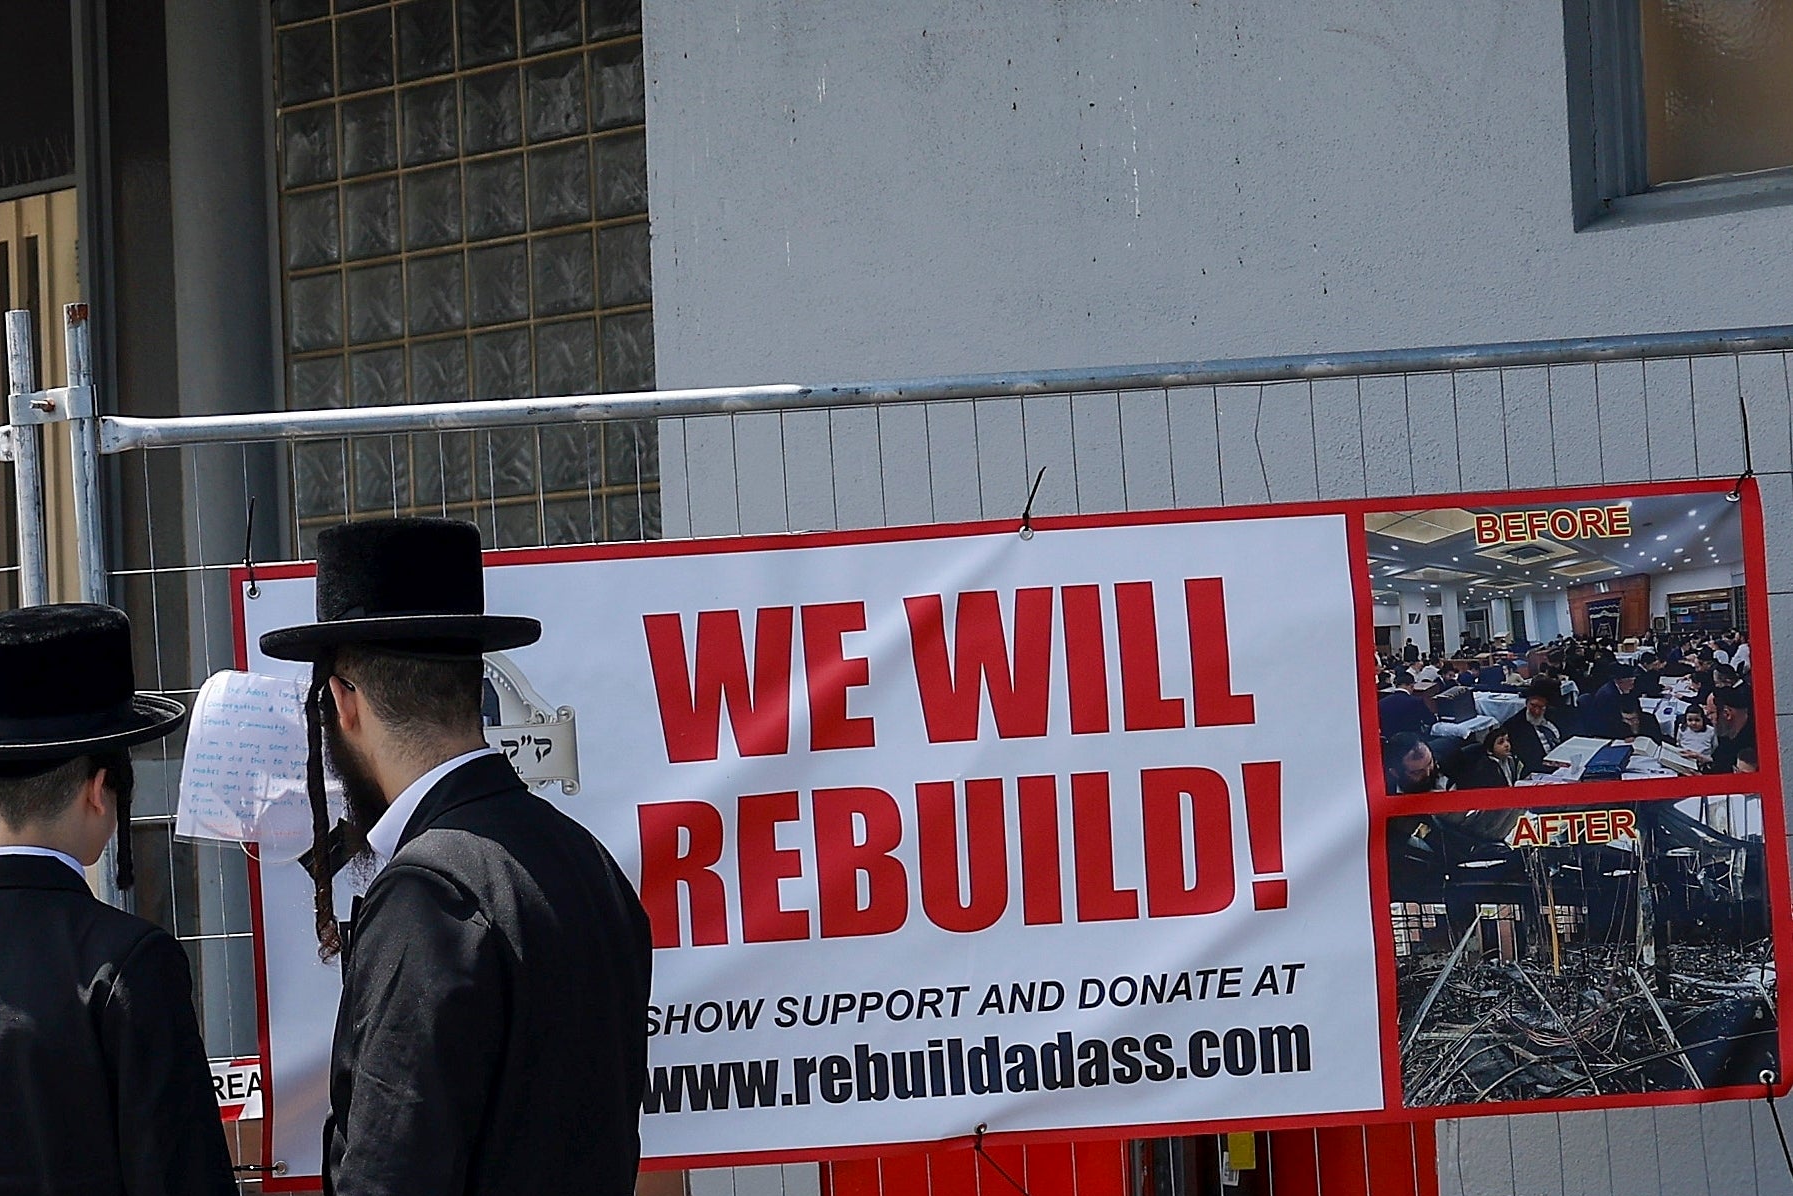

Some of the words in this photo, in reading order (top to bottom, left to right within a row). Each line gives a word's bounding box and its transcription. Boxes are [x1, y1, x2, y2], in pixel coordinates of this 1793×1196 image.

[1475, 506, 1631, 545] BEFORE
[642, 600, 876, 764] WE
[902, 576, 1256, 744] WILL
[636, 760, 1289, 949] REBUILD!
[1512, 809, 1637, 848] AFTER
[647, 998, 765, 1036] SHOW
[774, 985, 970, 1028] SUPPORT
[977, 981, 1065, 1016] AND
[1078, 966, 1243, 1010] DONATE
[1252, 963, 1306, 997] AT
[212, 1071, 262, 1100] REA
[643, 1023, 1312, 1115] www.rebuildadass.com
